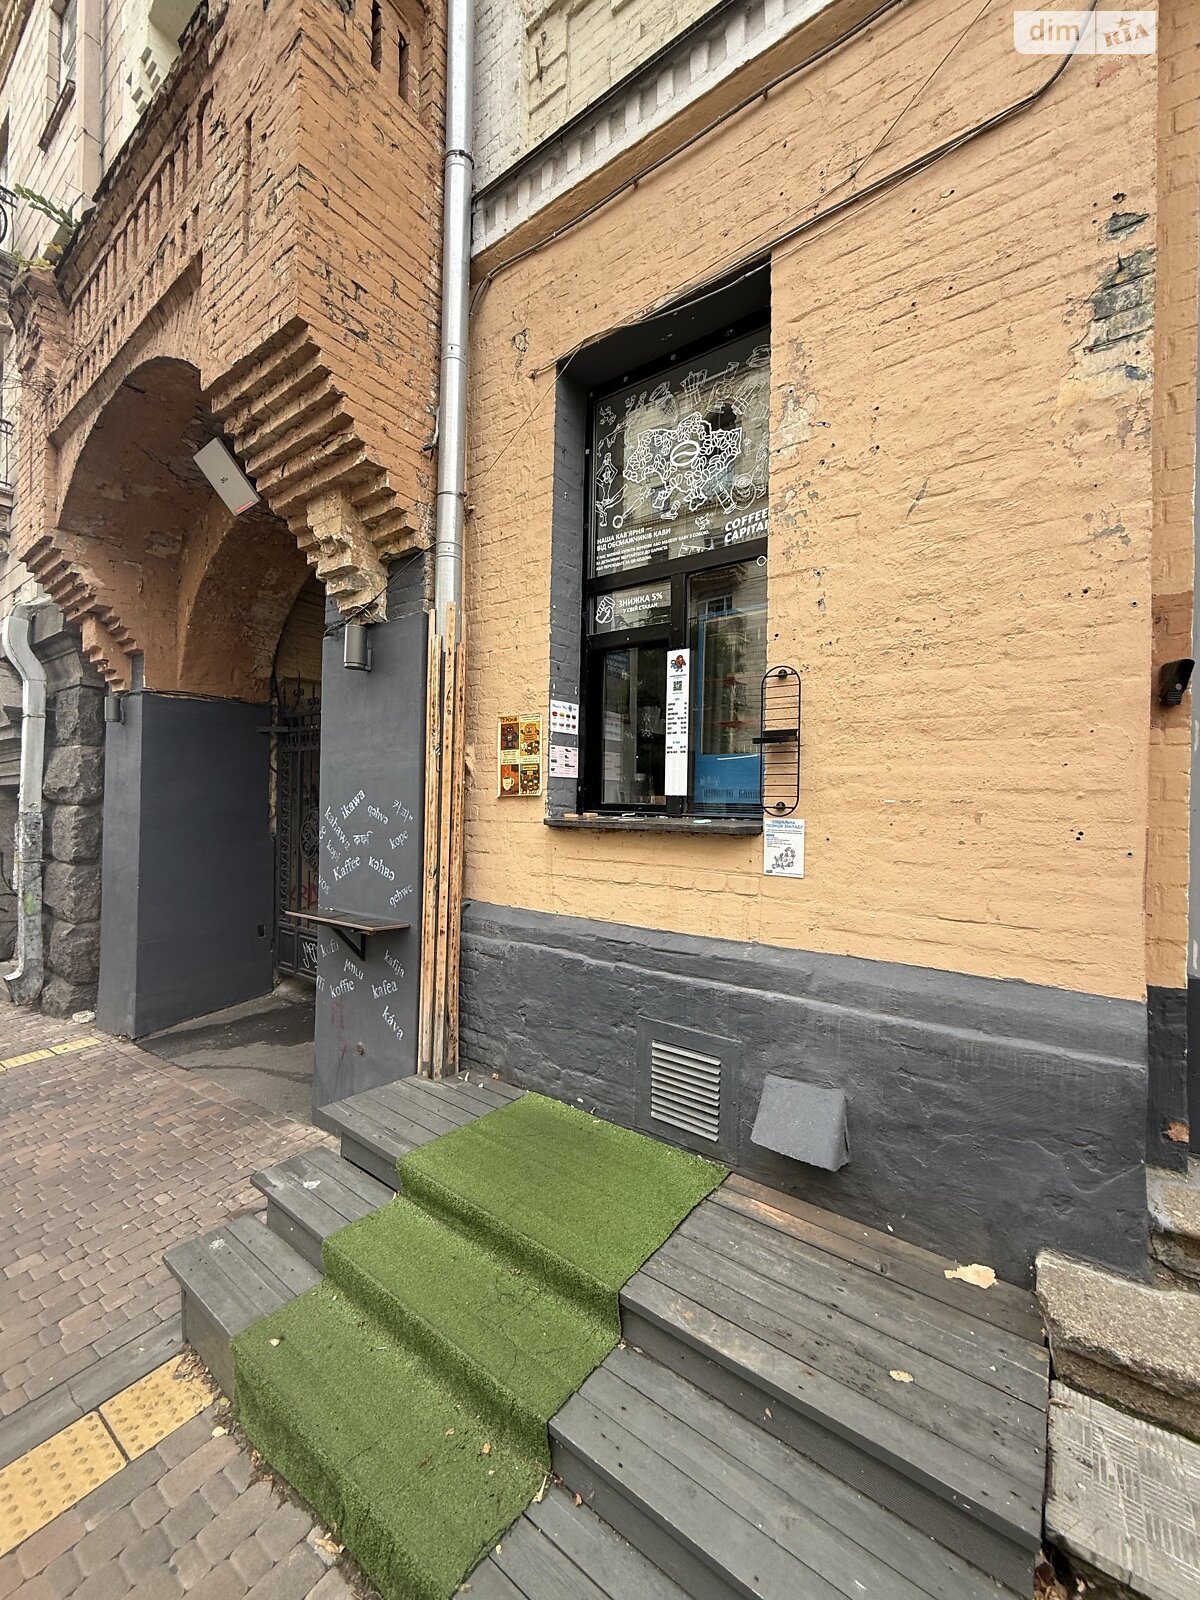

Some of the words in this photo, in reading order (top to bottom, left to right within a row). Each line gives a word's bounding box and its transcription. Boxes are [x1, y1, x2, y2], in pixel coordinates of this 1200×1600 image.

[725, 508, 768, 532] COFFEE
[596, 544, 607, 552] ВІД
[653, 528, 671, 538] КАВИ
[597, 535, 615, 545] НАША
[618, 594, 651, 607] ЗНИЖКА
[651, 591, 663, 601] 5%
[638, 602, 658, 611] СТАКАН
[341, 789, 366, 820] ikawa
[324, 805, 351, 851] kahawa
[332, 856, 361, 882] Kaffee
[389, 883, 414, 908] qehwe
[384, 949, 405, 978] kafija
[329, 978, 355, 998] koffie
[371, 979, 399, 999] kafea
[382, 1005, 404, 1041] káva
